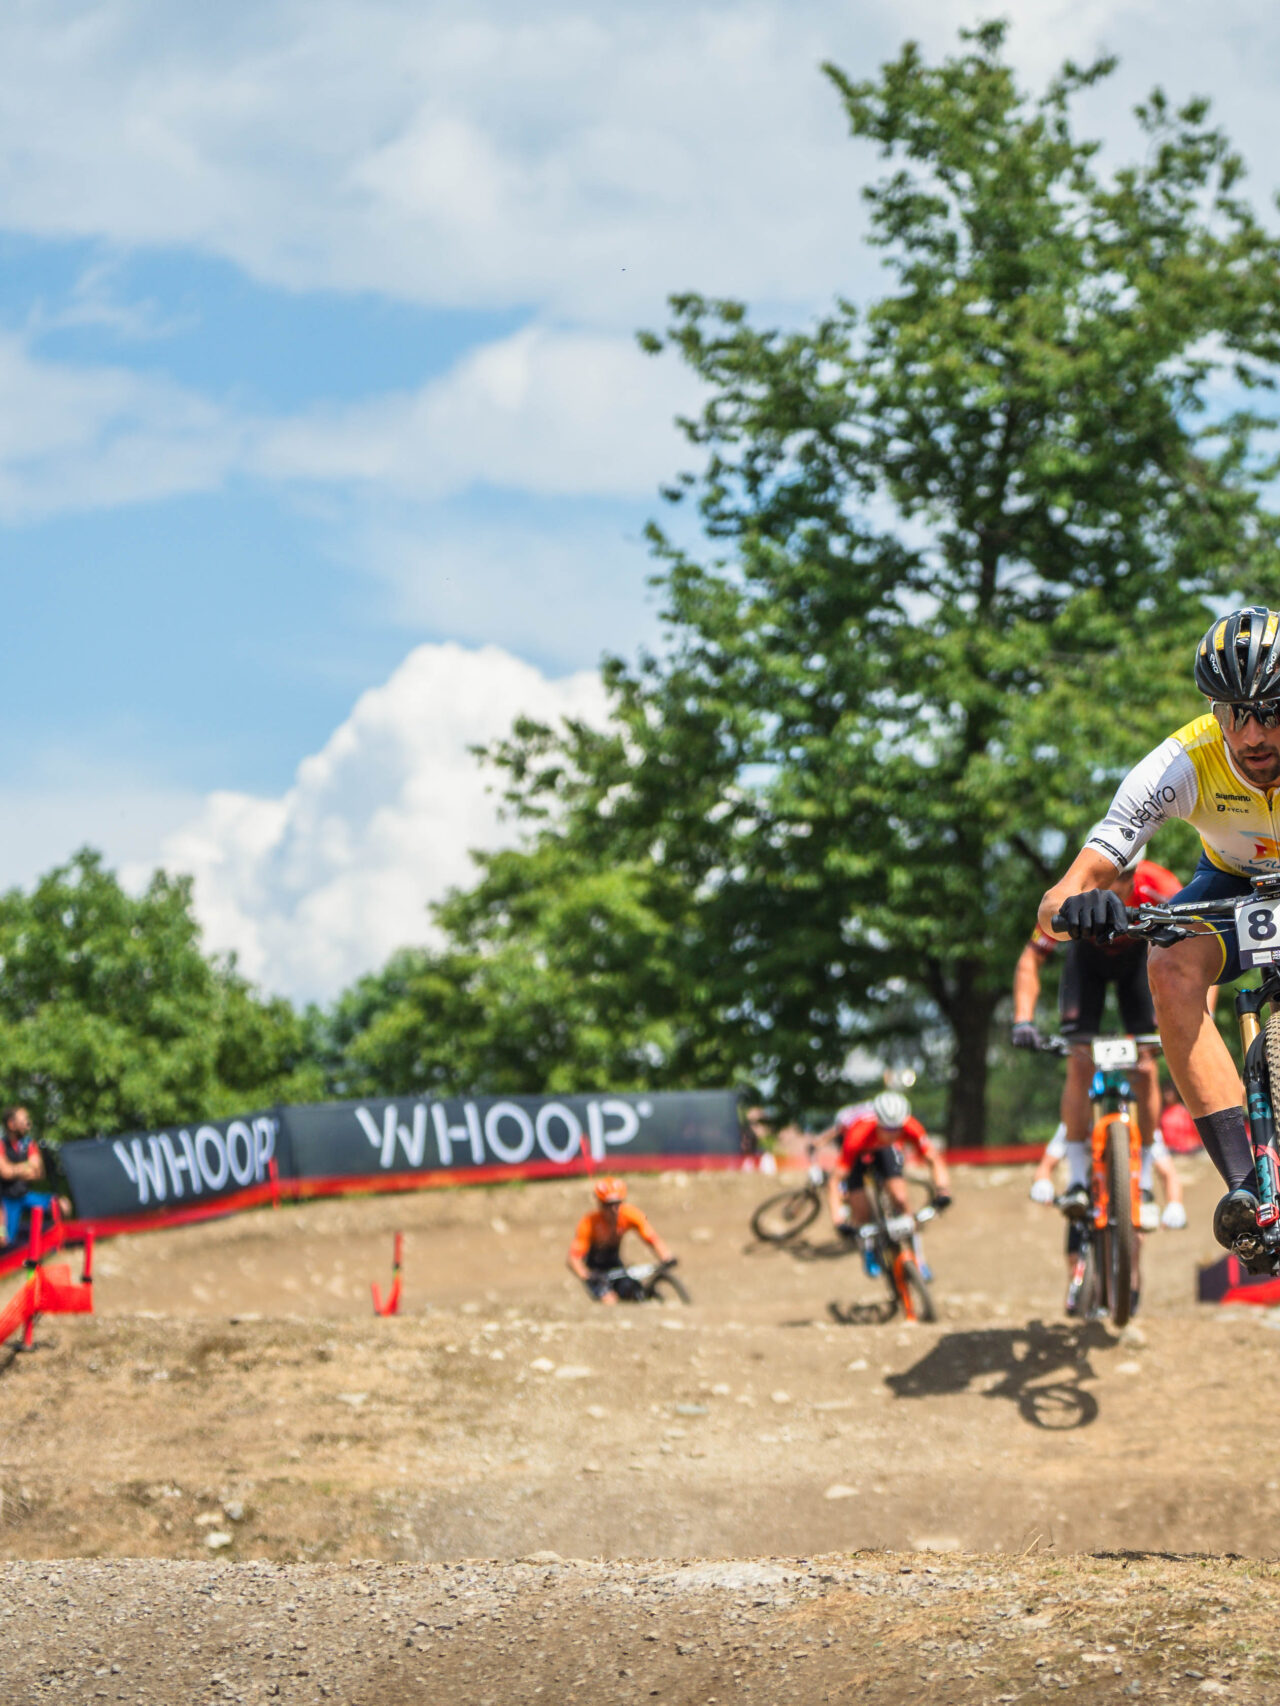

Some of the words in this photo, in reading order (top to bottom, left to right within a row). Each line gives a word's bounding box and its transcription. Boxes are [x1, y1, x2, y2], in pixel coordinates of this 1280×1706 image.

[1130, 786, 1176, 828] centro
[113, 1117, 276, 1204] WHOOP
[354, 1100, 641, 1168] WHOOP
